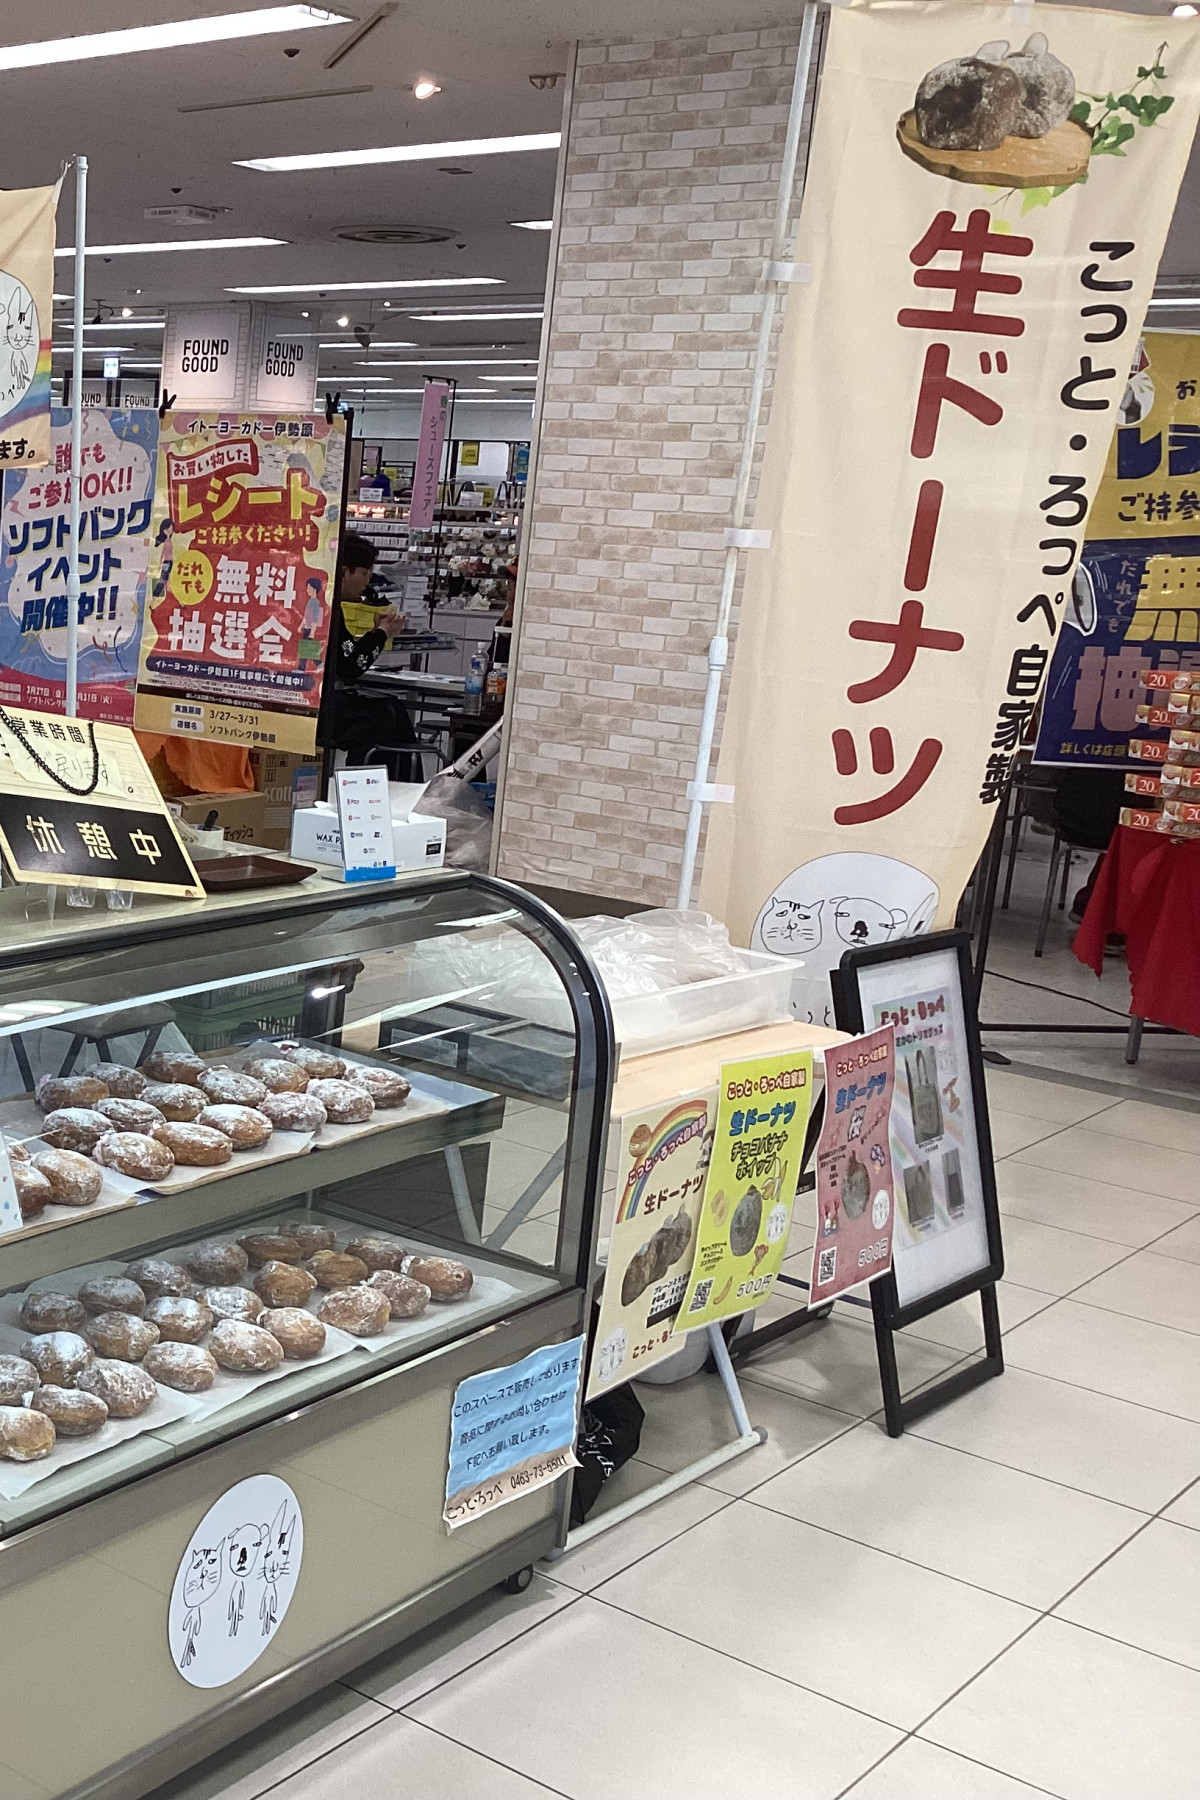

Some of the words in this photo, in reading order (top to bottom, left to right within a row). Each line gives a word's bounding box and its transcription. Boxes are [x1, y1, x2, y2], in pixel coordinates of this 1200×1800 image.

[183, 339, 229, 356] FOUND
[267, 341, 304, 361] FOUND
[181, 356, 219, 373] GOOD
[265, 359, 295, 378] GOOD
[125, 394, 150, 408] FOUND
[187, 420, 314, 438] イトーヨーカドー伊勢原
[173, 448, 250, 477] お買い物した
[178, 471, 319, 524] レシート
[8, 498, 151, 556] ソフトバンク
[833, 208, 1033, 826] 生ドーナツ
[980, 241, 1135, 804] こっと・ろっぺ自家製
[176, 561, 204, 576] だれ
[181, 580, 206, 595] でも
[213, 554, 297, 609] 無料
[167, 608, 293, 665] 抽選会
[1150, 674, 1167, 687] 20
[1151, 710, 1168, 723] 20
[1143, 745, 1161, 758] 20
[1138, 780, 1156, 793] 20
[1133, 814, 1150, 827] 20
[25, 814, 163, 866] 休憩中
[729, 1100, 797, 1137] 生ドーナツ
[731, 1130, 789, 1163] チョコバナナ
[735, 1152, 777, 1181] ホイップ
[643, 1174, 704, 1216] 生ドーナツ
[736, 1274, 773, 1298] 500円
